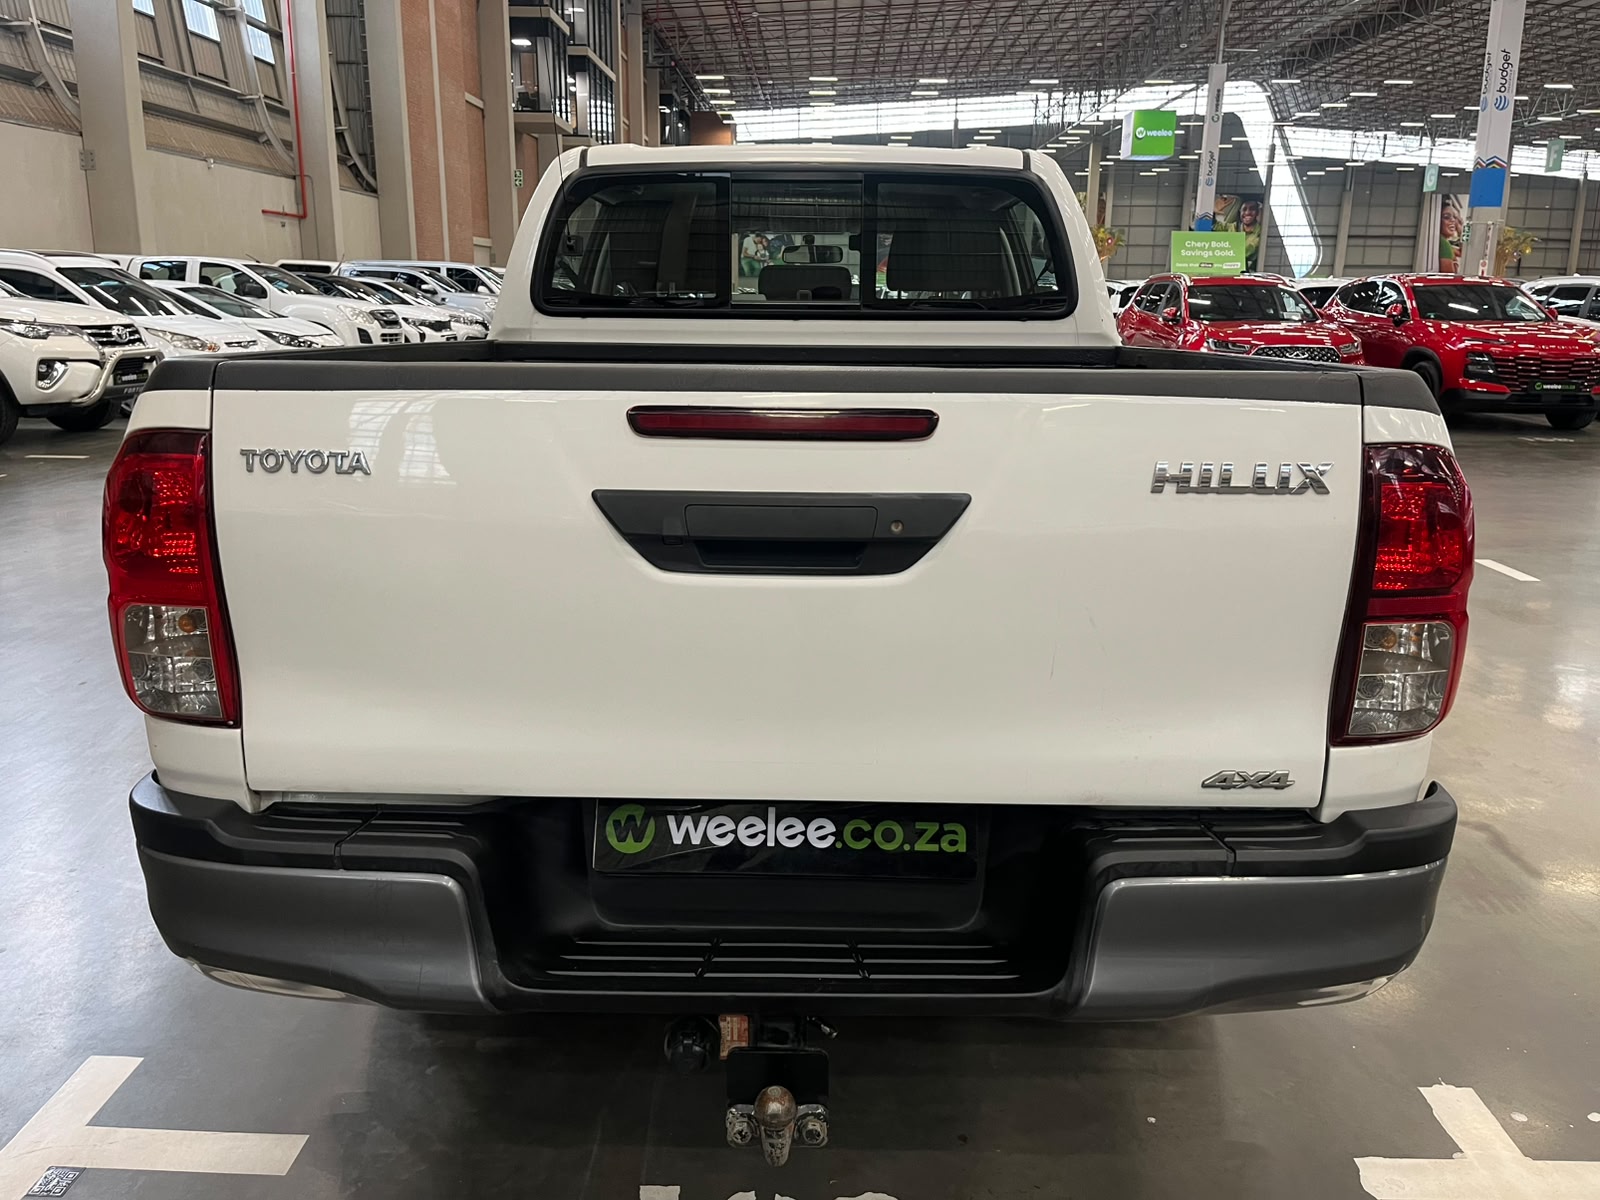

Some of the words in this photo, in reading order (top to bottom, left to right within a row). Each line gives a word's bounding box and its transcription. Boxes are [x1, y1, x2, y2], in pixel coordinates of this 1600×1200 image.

[1496, 48, 1514, 93] budget
[1549, 143, 1560, 168] F
[1426, 167, 1436, 187] G
[1181, 249, 1213, 258] Savings
[1214, 249, 1236, 257] Gold.
[1185, 240, 1210, 250] Chery
[1211, 240, 1231, 248] Bold.
[240, 448, 371, 475] TOYOTA
[1151, 461, 1335, 495] HILUX
[666, 806, 967, 853] weelee.co.za
